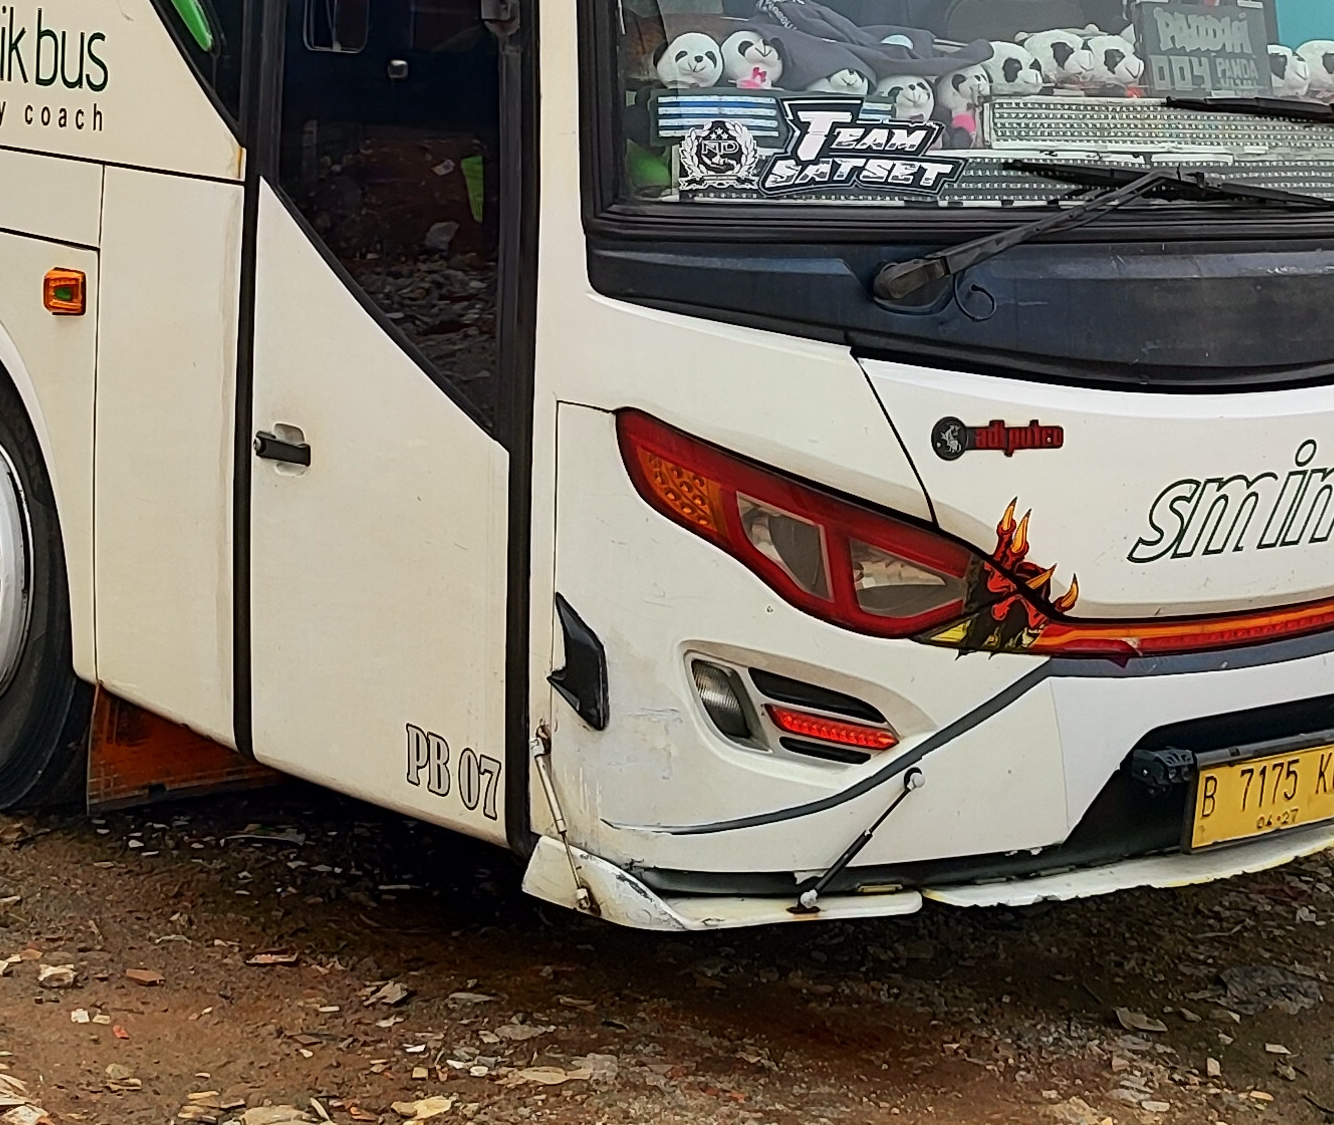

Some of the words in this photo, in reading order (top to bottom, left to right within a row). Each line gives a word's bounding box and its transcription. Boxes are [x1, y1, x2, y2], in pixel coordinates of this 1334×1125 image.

[24, 103, 104, 132] coach
[764, 157, 954, 189] SATSET
[405, 722, 451, 798] PB
[457, 746, 503, 821] 07
[1199, 775, 1217, 819] B
[1238, 758, 1301, 813] 7175
